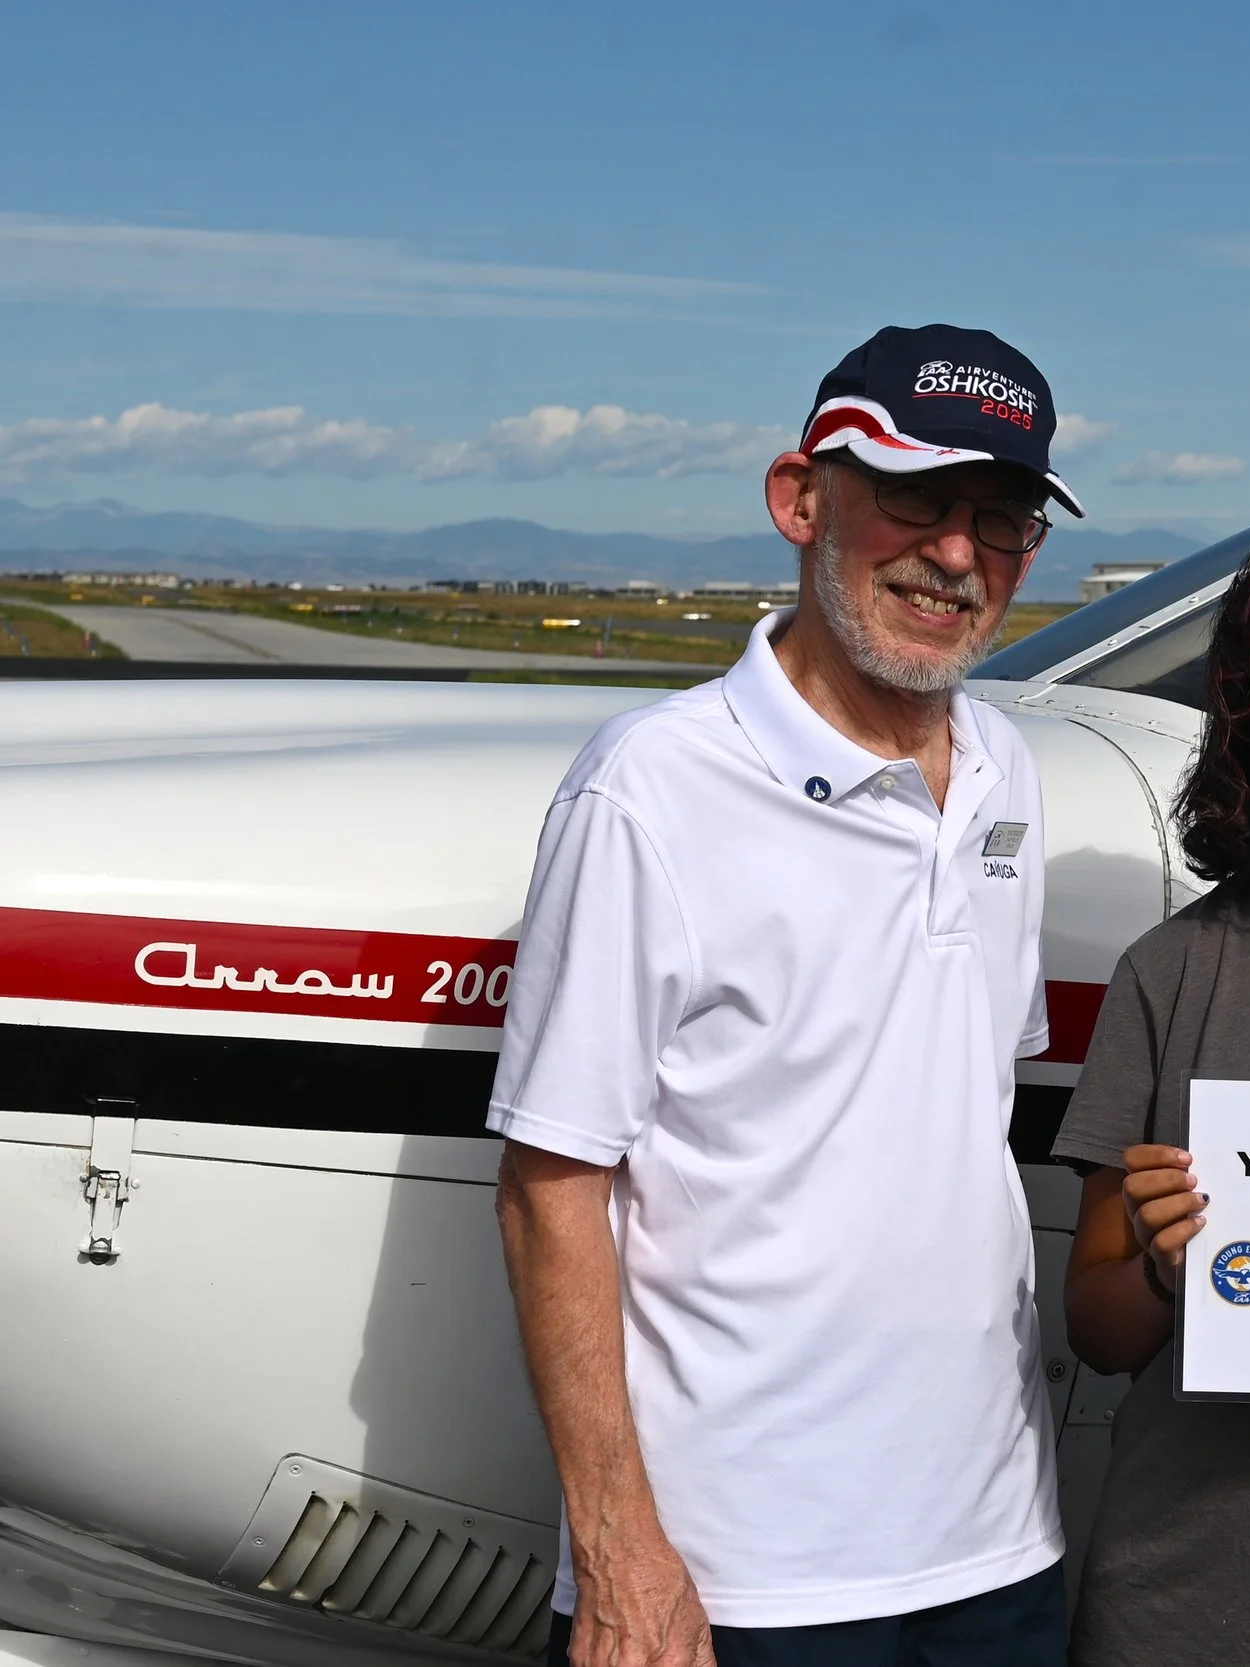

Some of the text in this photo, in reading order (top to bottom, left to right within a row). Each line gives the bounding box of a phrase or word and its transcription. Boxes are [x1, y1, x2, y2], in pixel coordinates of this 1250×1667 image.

[914, 375, 1034, 416] OSHKOSH
[955, 365, 1036, 400] AIRVENTURE
[980, 399, 1033, 431] 2025
[420, 960, 515, 1008] 200
[1217, 1245, 1243, 1266] YOUNG
